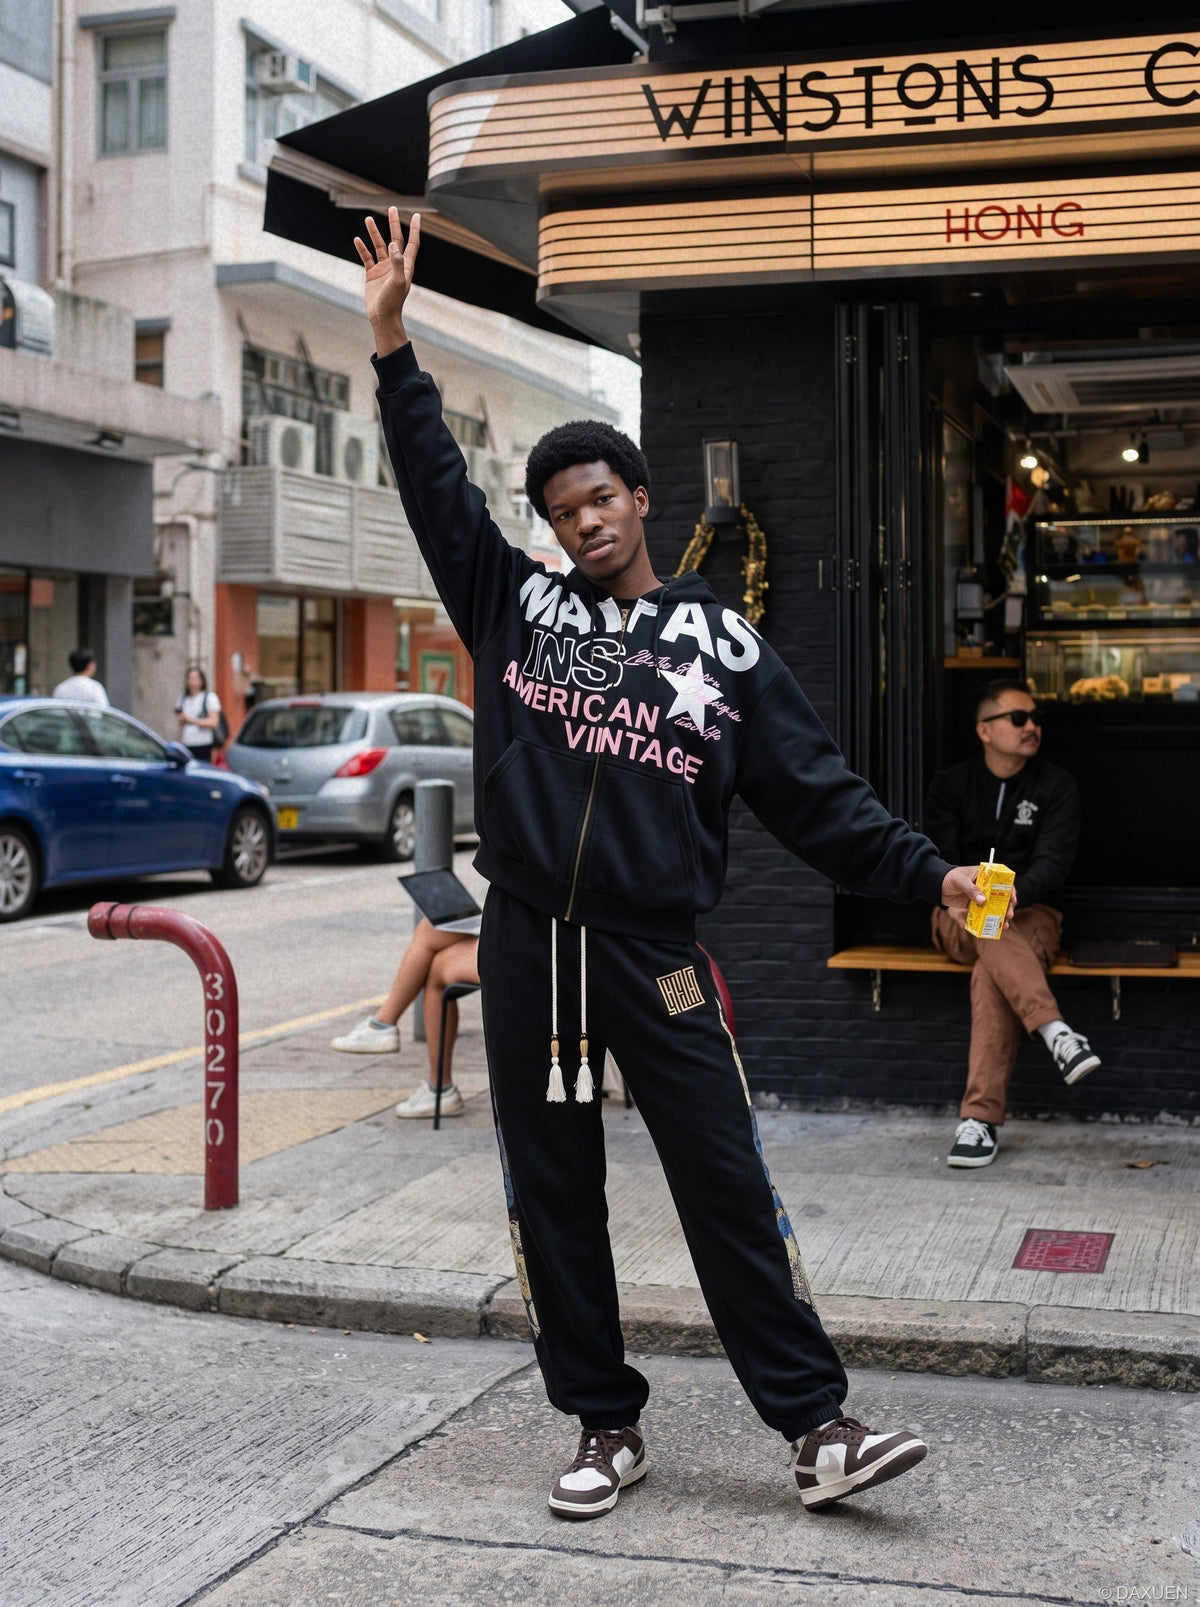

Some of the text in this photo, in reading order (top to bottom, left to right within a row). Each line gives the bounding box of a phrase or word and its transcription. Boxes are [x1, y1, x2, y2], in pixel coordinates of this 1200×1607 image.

[642, 54, 1055, 142] WINSTONS
[945, 202, 1085, 243] HONG
[502, 659, 660, 733] AMERICAN
[564, 720, 704, 784] VINTAGE
[205, 972, 226, 1146] 30270
